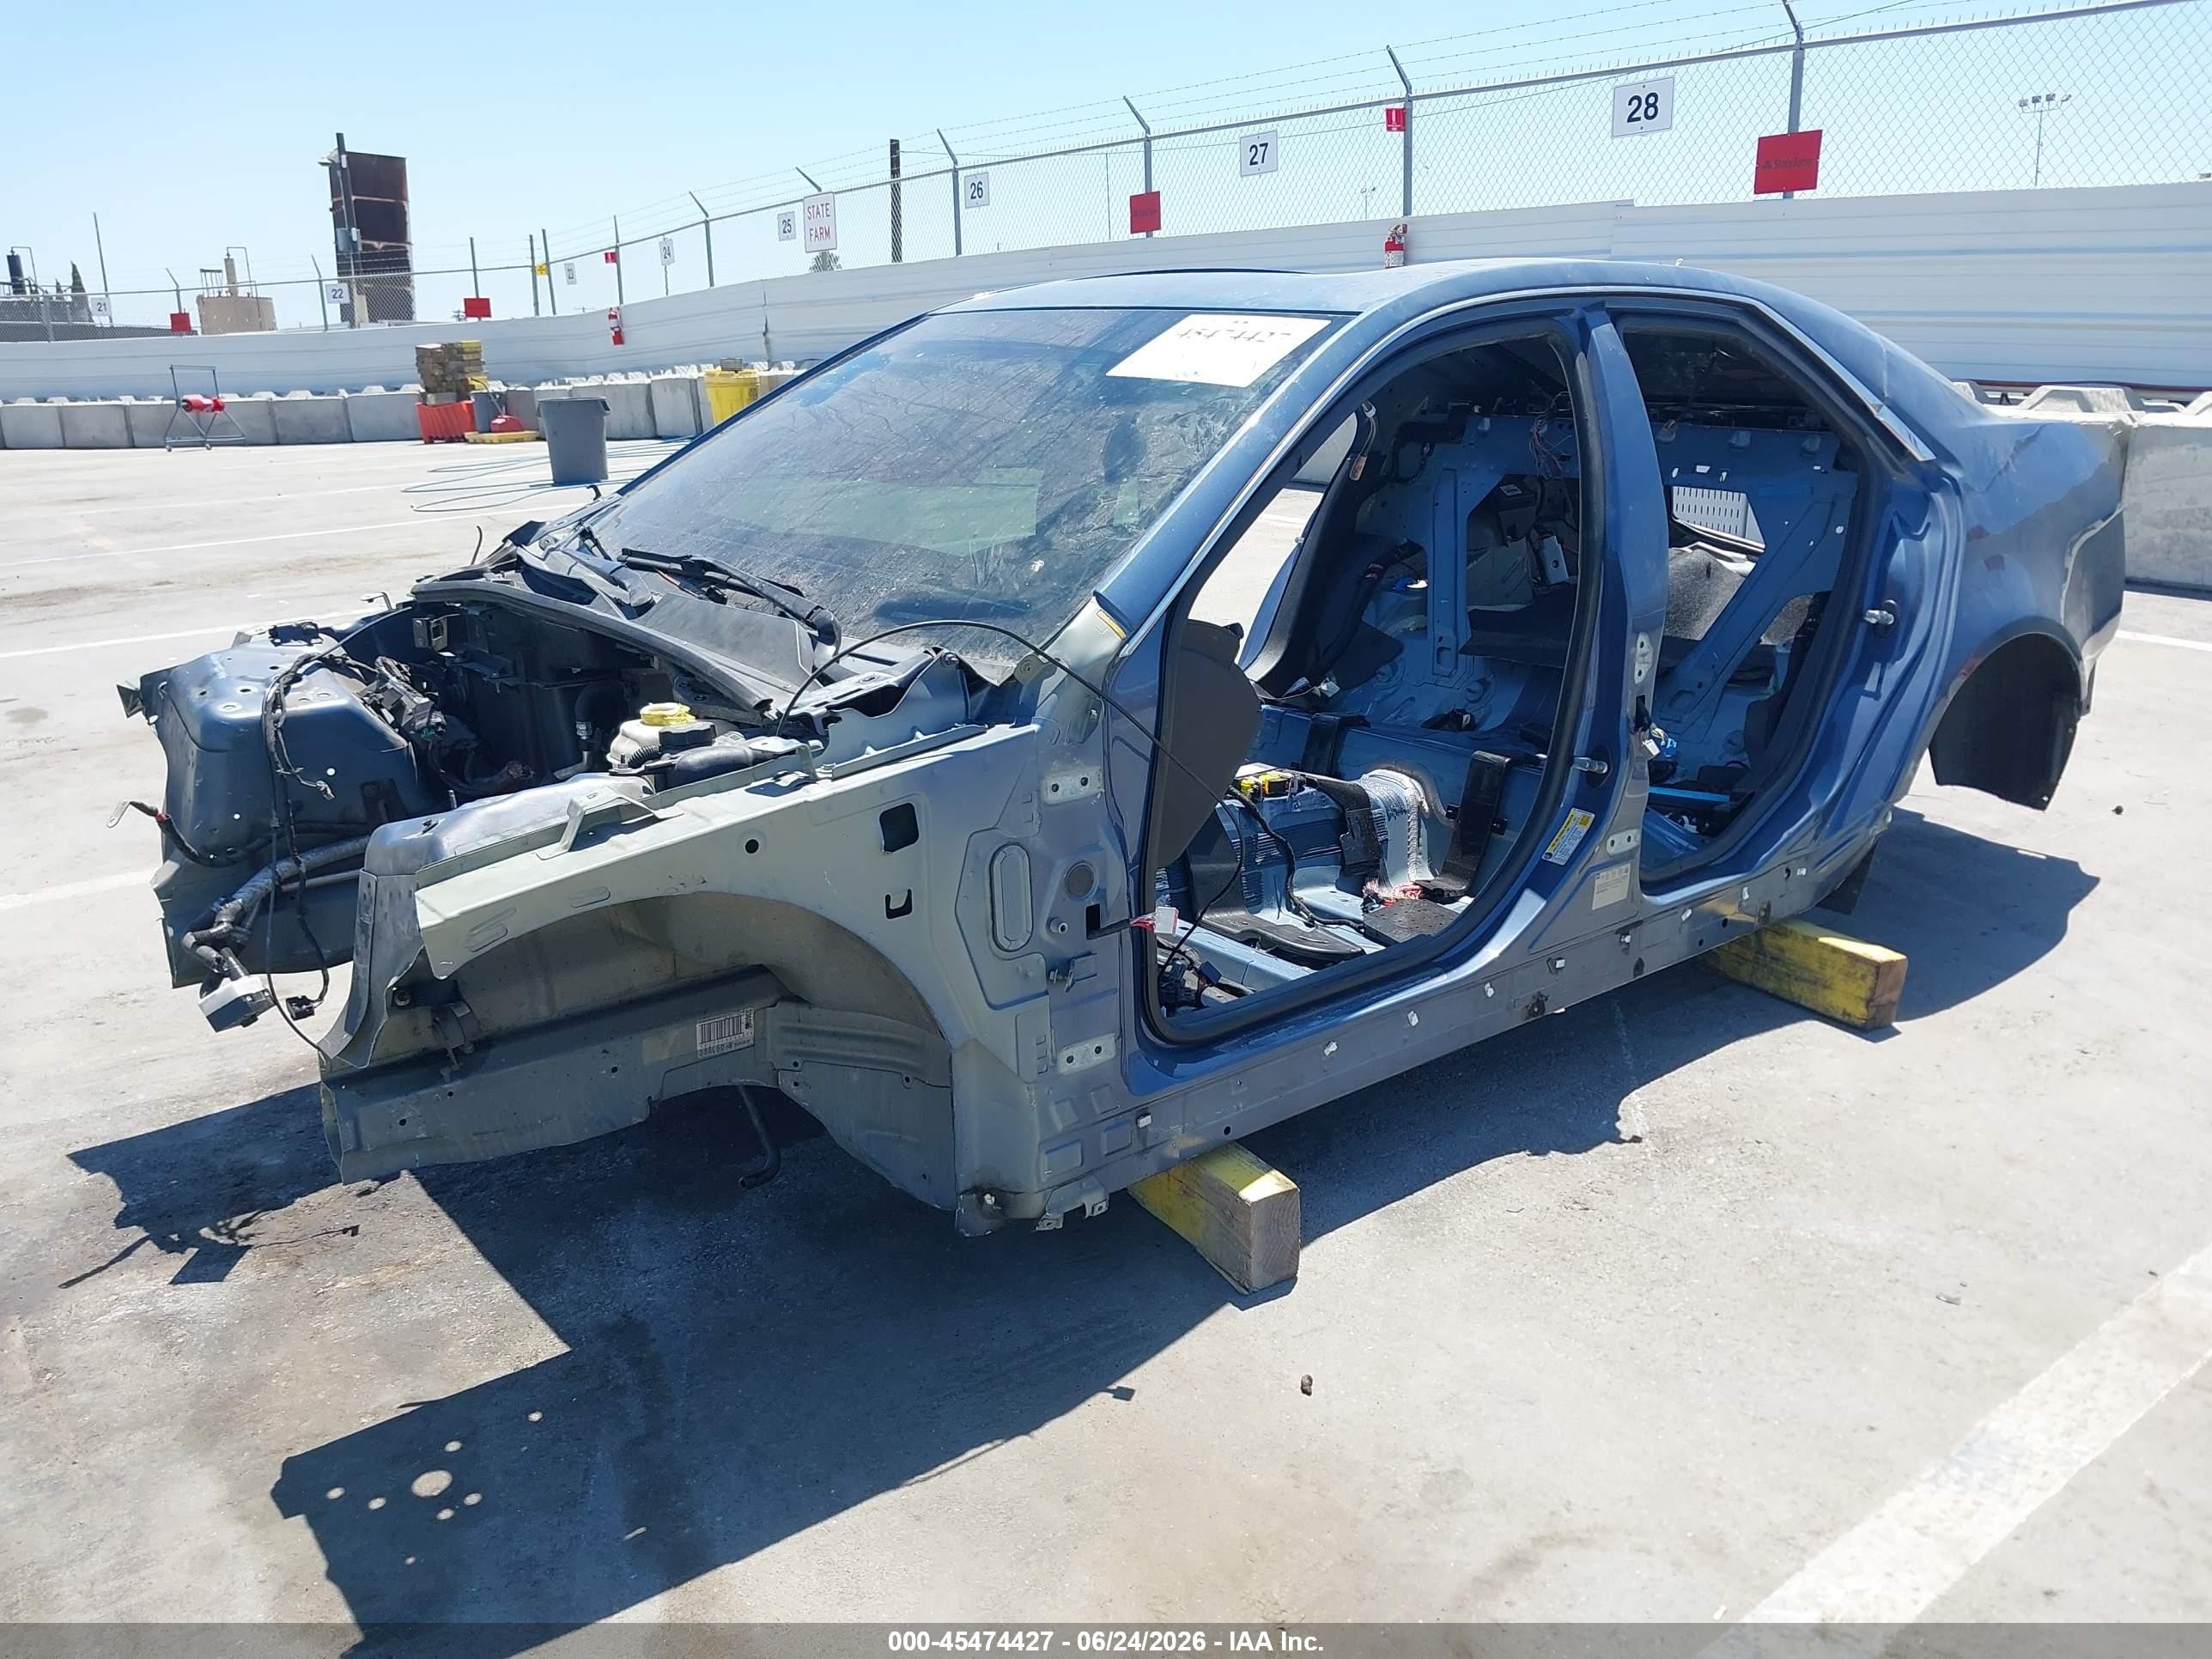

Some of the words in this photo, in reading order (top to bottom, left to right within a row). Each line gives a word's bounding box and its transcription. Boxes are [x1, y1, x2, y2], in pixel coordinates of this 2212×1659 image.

[1626, 92, 1659, 123] 28
[1249, 142, 1268, 166] 27
[970, 181, 983, 199] 26
[807, 203, 830, 220] STATE
[782, 219, 792, 234] 25
[809, 226, 831, 243] FARM
[331, 289, 343, 299] 22
[97, 302, 107, 312] 21
